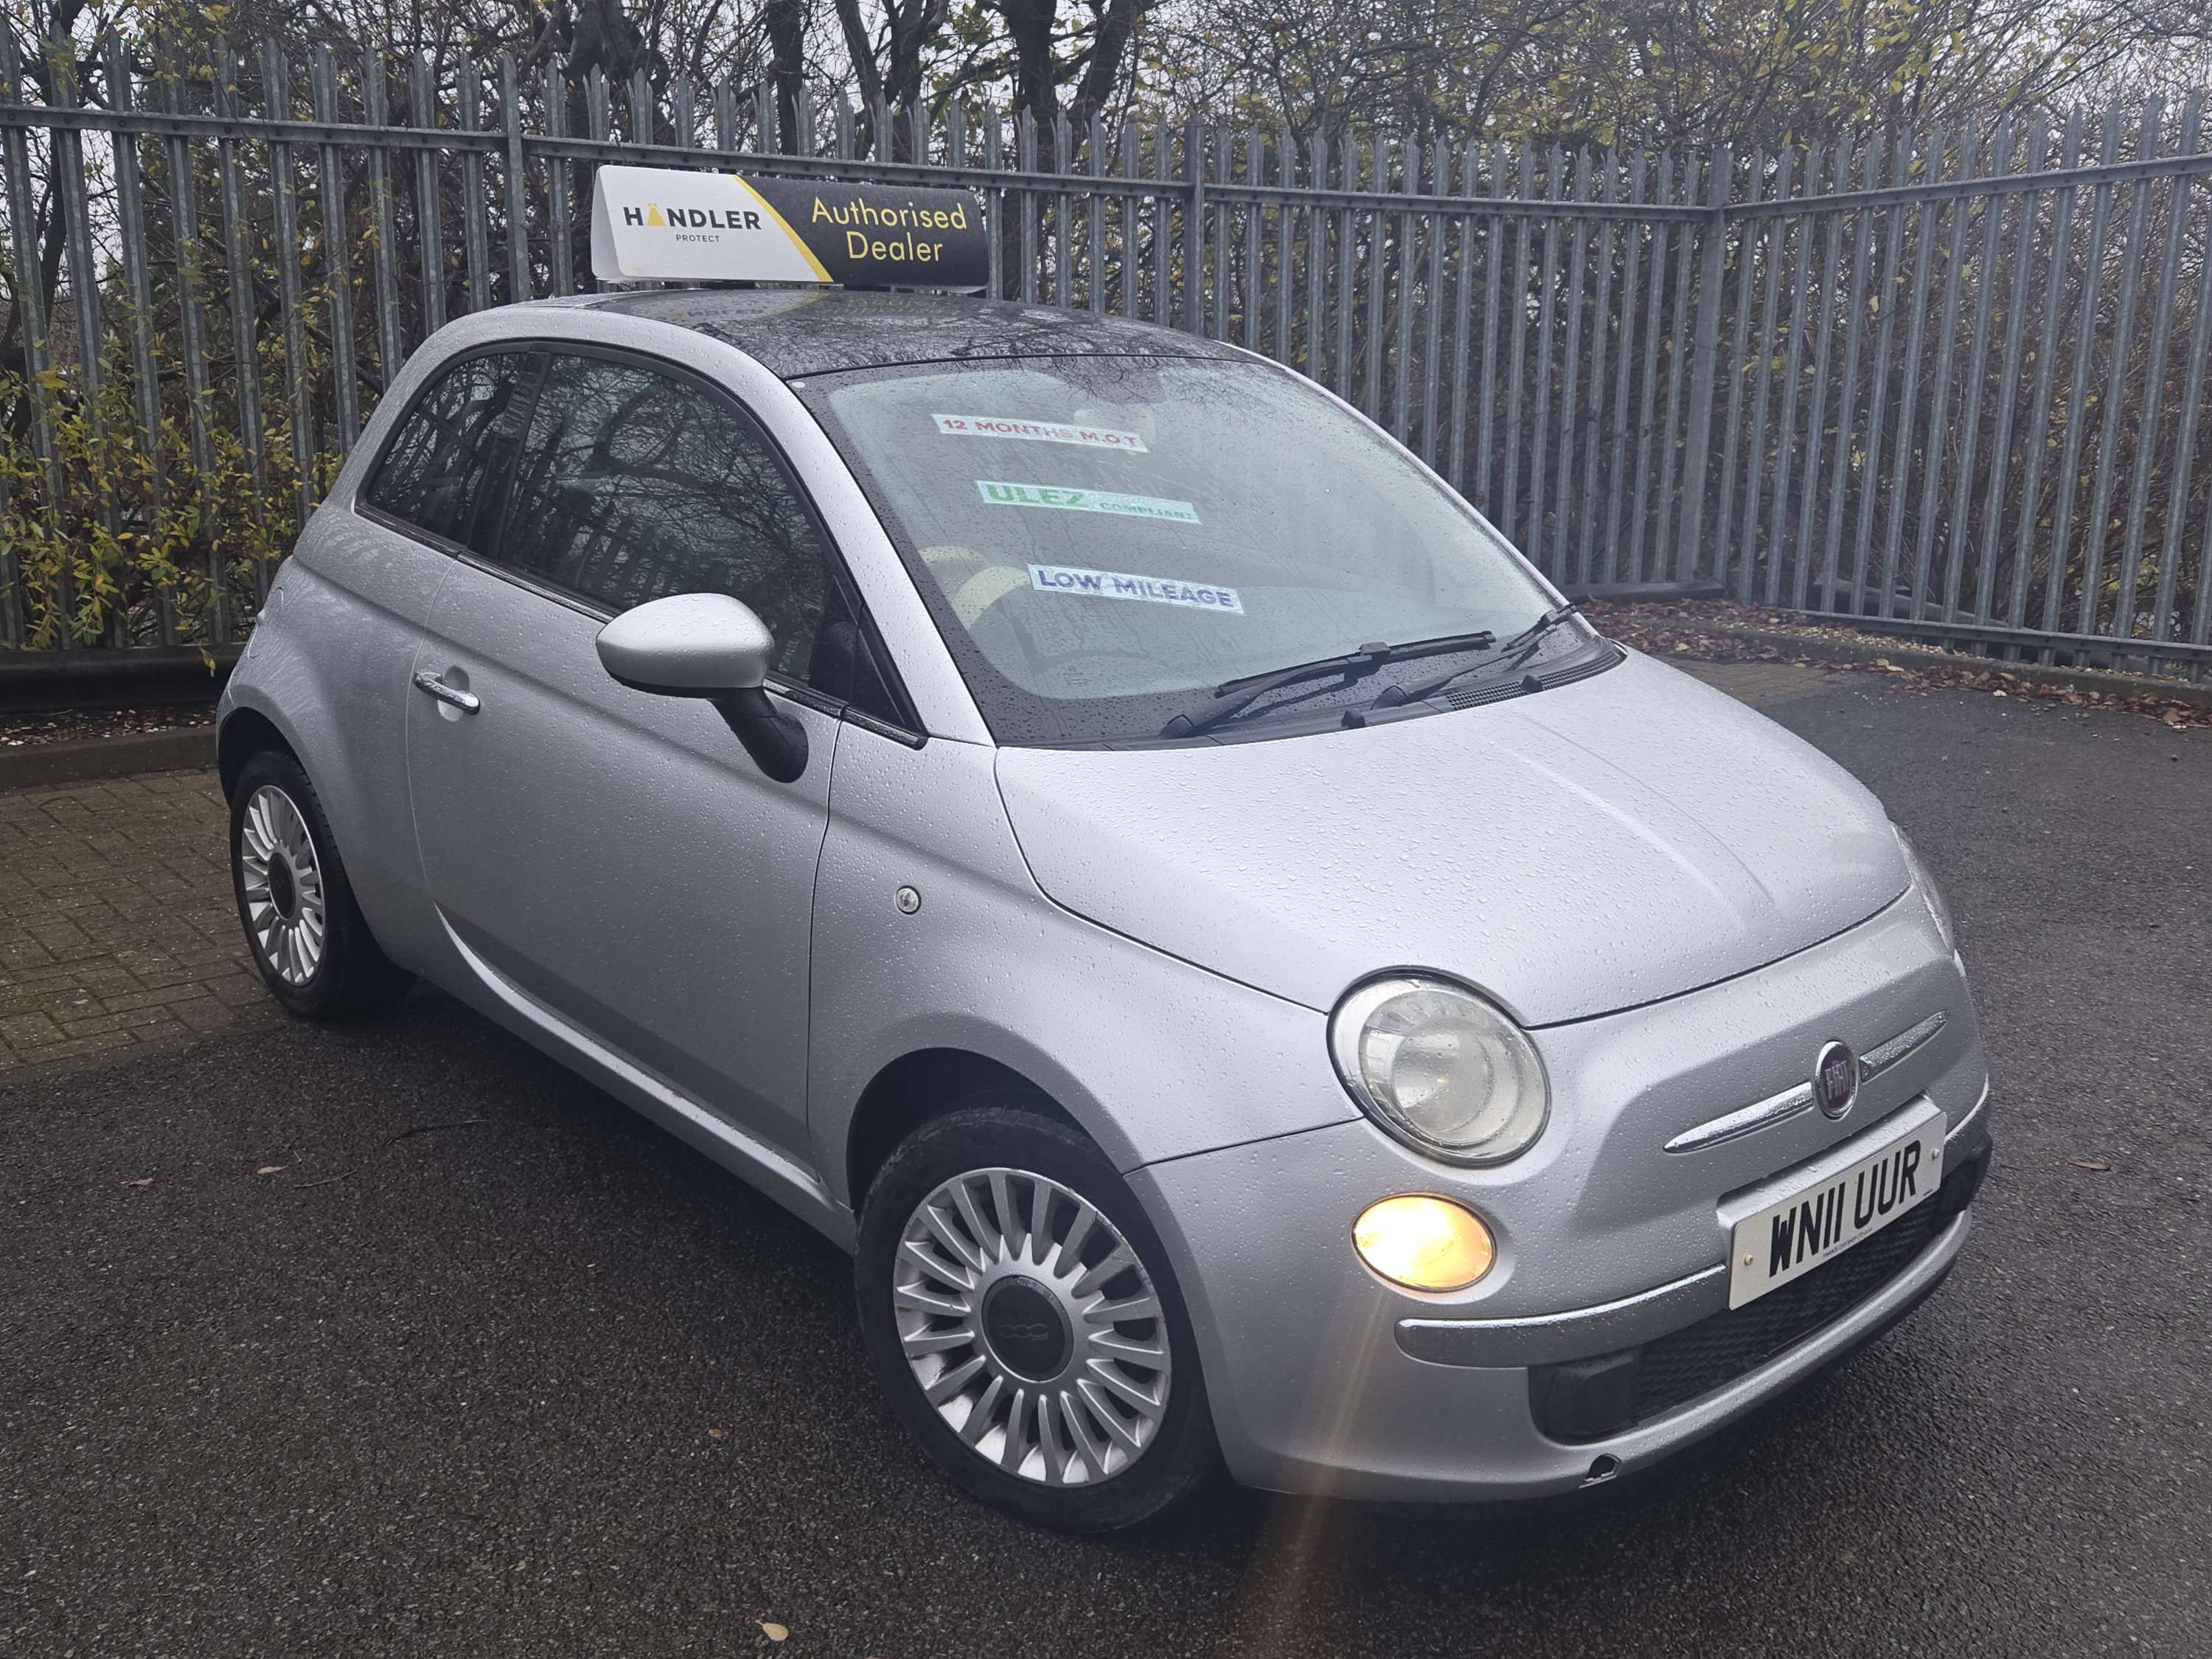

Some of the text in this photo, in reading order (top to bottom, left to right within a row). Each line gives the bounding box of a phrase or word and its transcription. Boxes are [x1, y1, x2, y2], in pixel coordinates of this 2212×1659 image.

[813, 197, 967, 229] Authorised
[675, 234, 720, 243] PROTECT
[846, 231, 944, 262] Dealer
[943, 419, 968, 430] 12
[974, 421, 1074, 439] MONTHS
[986, 484, 1088, 507] ULEZ
[1038, 569, 1234, 608] LOW MILEAGE
[1854, 1140, 1921, 1230] UUR
